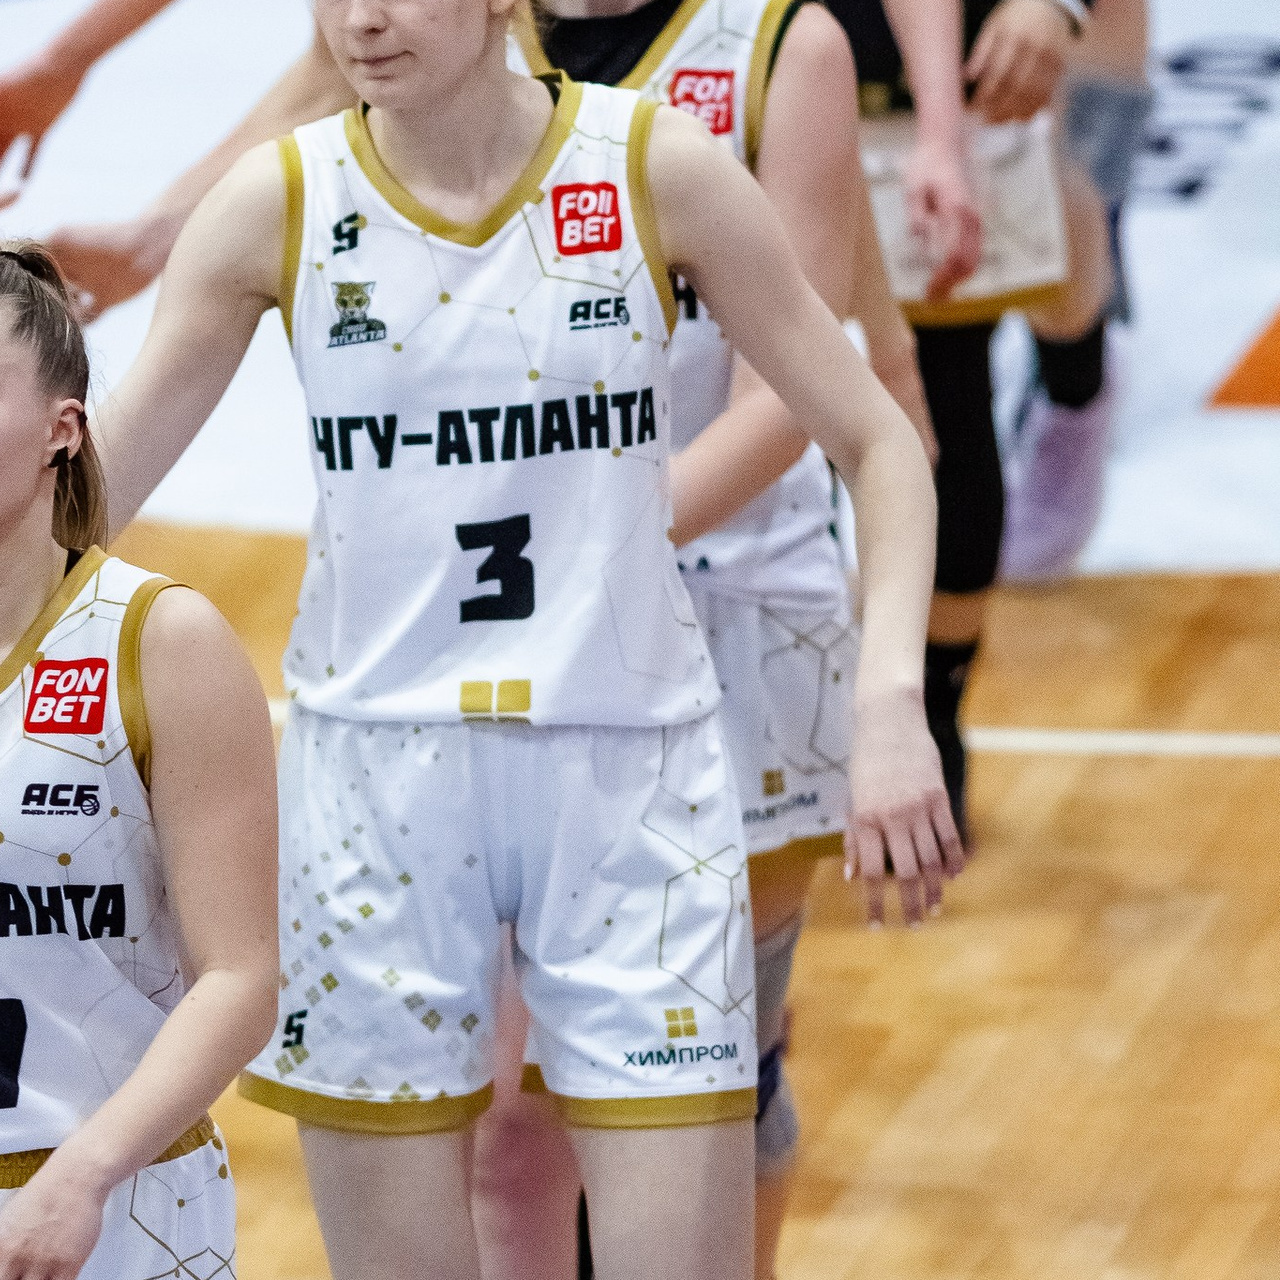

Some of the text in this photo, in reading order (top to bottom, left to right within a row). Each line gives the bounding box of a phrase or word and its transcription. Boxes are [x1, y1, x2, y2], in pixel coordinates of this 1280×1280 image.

[561, 215, 617, 248] BET
[455, 513, 535, 624] 3
[34, 666, 106, 694] FON
[29, 695, 101, 723] BET
[623, 1042, 738, 1066] ХИМПРОМ
